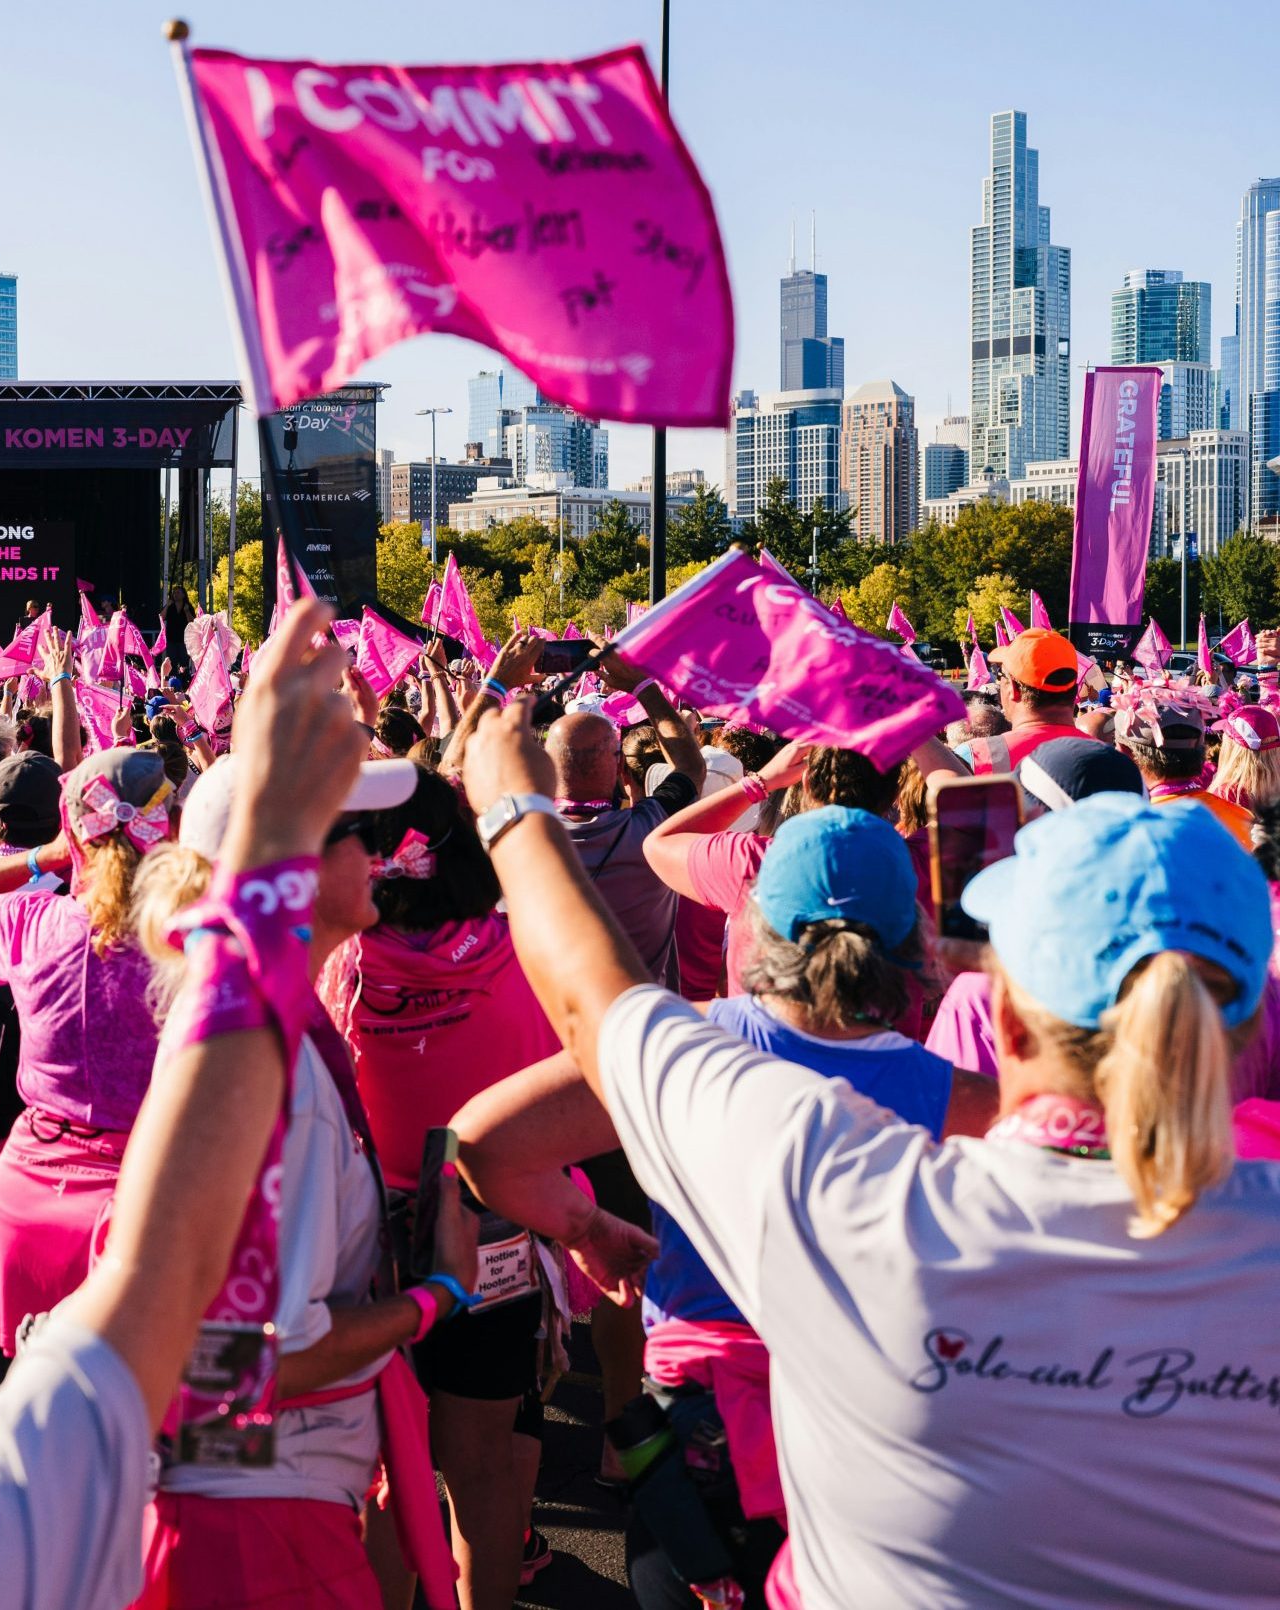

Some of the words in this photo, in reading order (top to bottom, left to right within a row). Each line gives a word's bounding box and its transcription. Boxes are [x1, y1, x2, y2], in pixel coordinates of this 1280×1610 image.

[292, 68, 613, 147] COMMIT
[422, 146, 496, 182] FOR
[283, 416, 330, 431] 3-Day
[6, 428, 104, 448] KOMEN
[112, 428, 192, 448] 3-DAY
[1110, 379, 1139, 512] GRATEFUL
[306, 544, 331, 552] AMGEN
[43, 567, 60, 581] IT
[452, 934, 478, 963] Every
[486, 1248, 520, 1265] Hotties
[490, 1266, 504, 1276] for
[478, 1274, 516, 1292] Hooters
